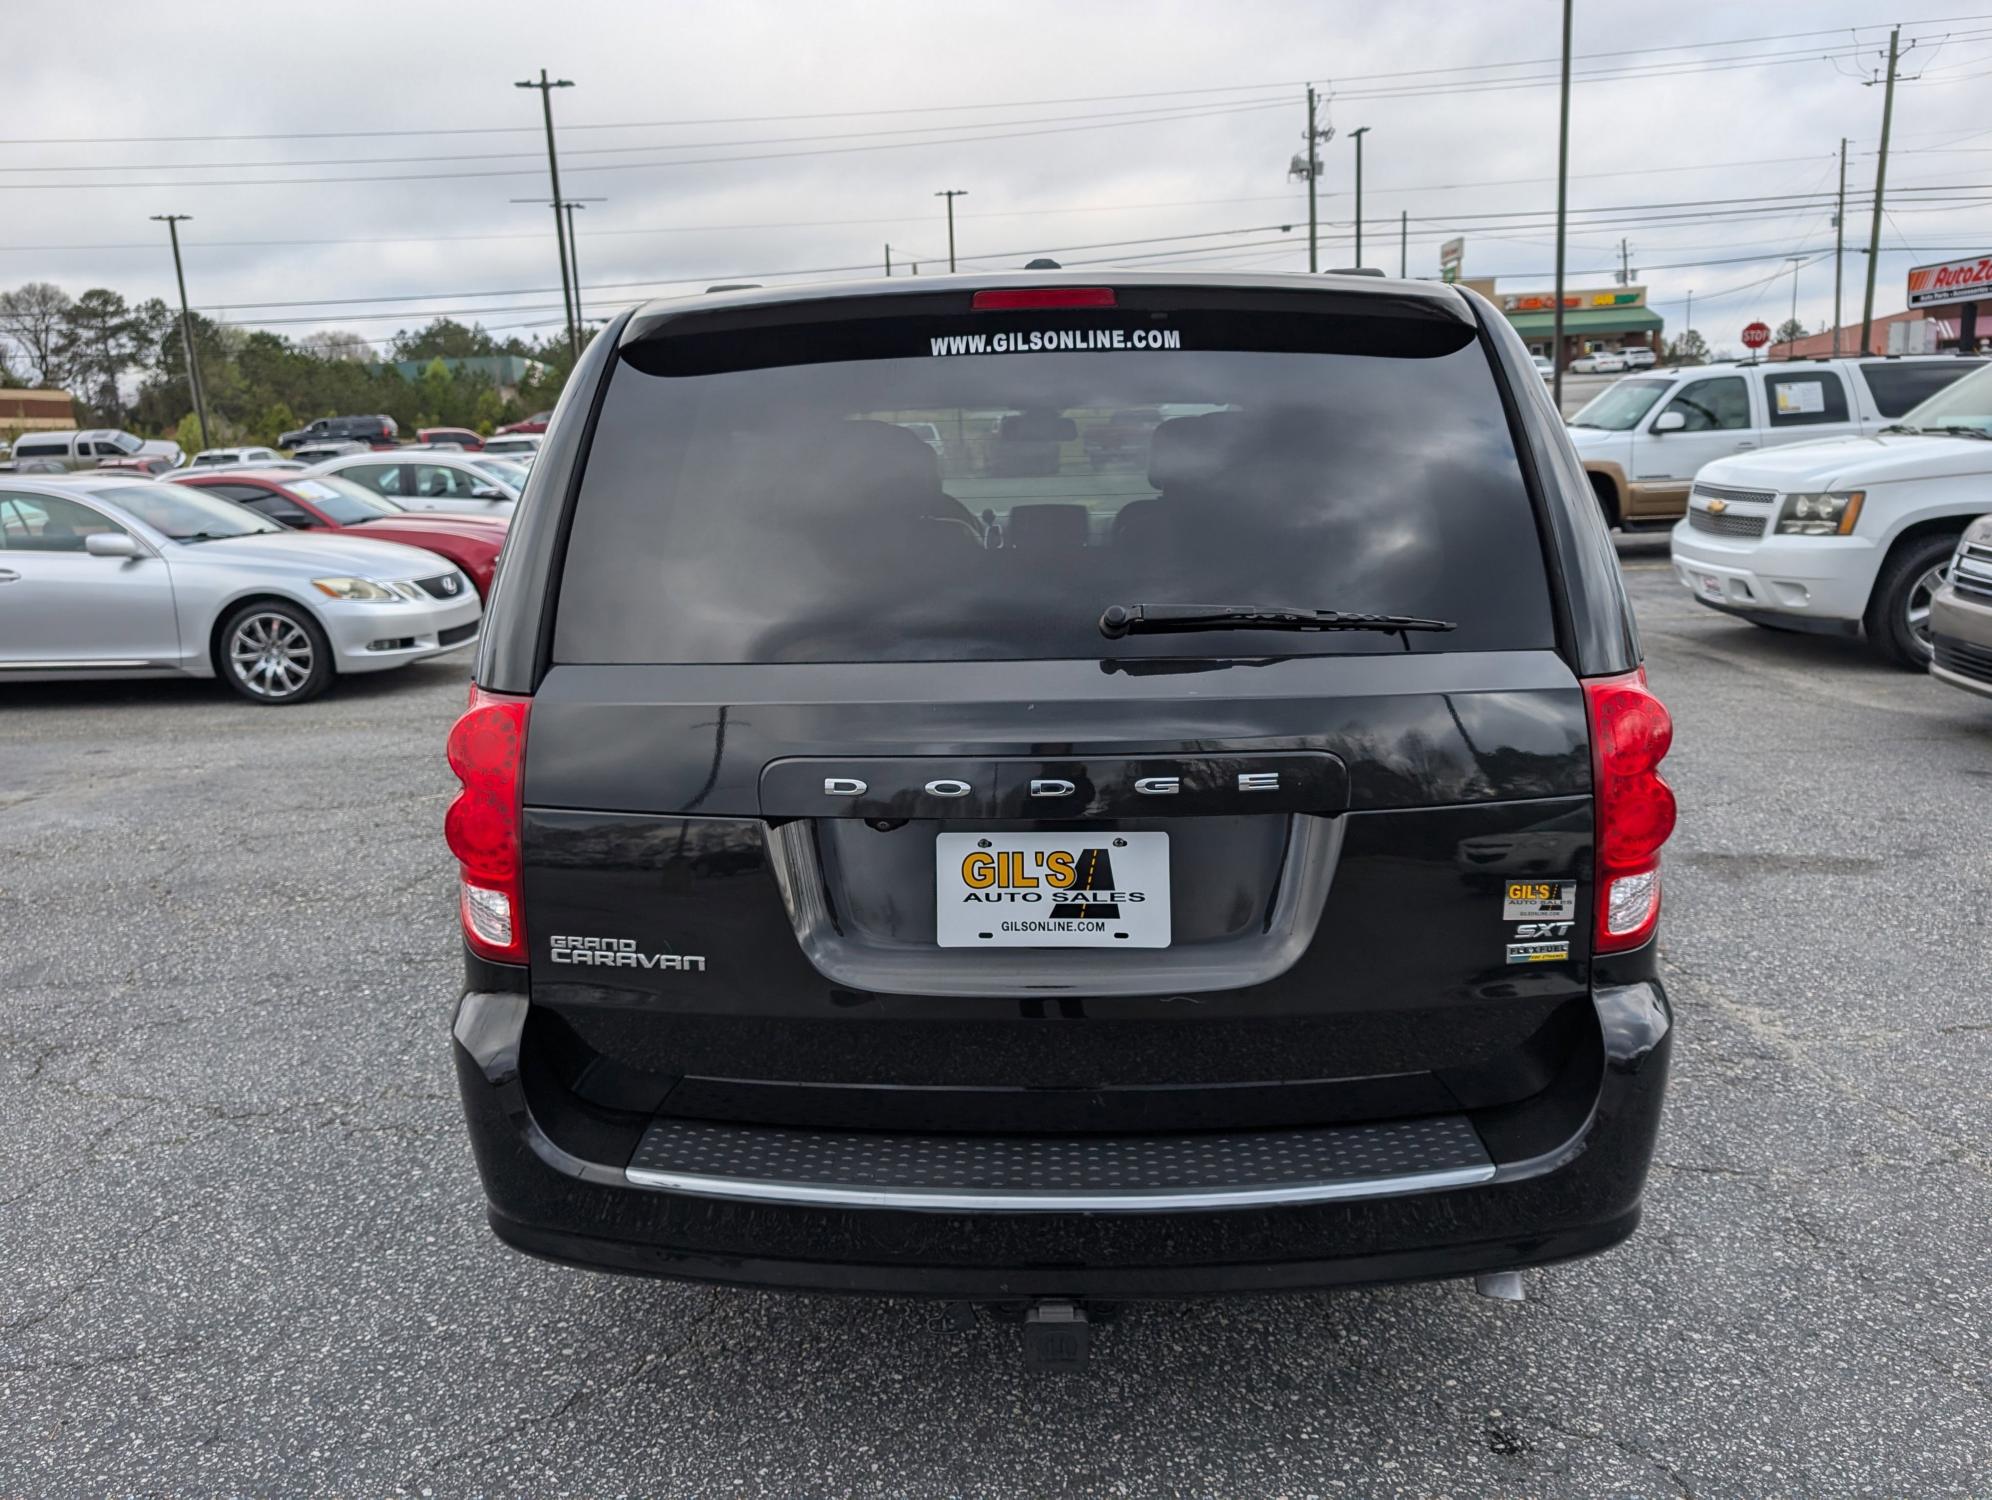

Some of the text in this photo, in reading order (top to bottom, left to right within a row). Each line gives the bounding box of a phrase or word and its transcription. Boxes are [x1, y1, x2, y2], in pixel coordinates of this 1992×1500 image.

[931, 330, 1181, 356] WWW.GILSONLINE.COM
[1743, 329, 1769, 342] STOP
[824, 772, 1280, 797] DODGE
[962, 851, 1077, 889] GIL'S
[963, 892, 1146, 903] AUTO SALES
[1508, 884, 1550, 900] GIL'S
[1001, 921, 1105, 932] GILSONLINE.COM
[1514, 921, 1575, 938] SXT
[550, 935, 637, 952] GRAND
[551, 948, 706, 972] CARAVAN
